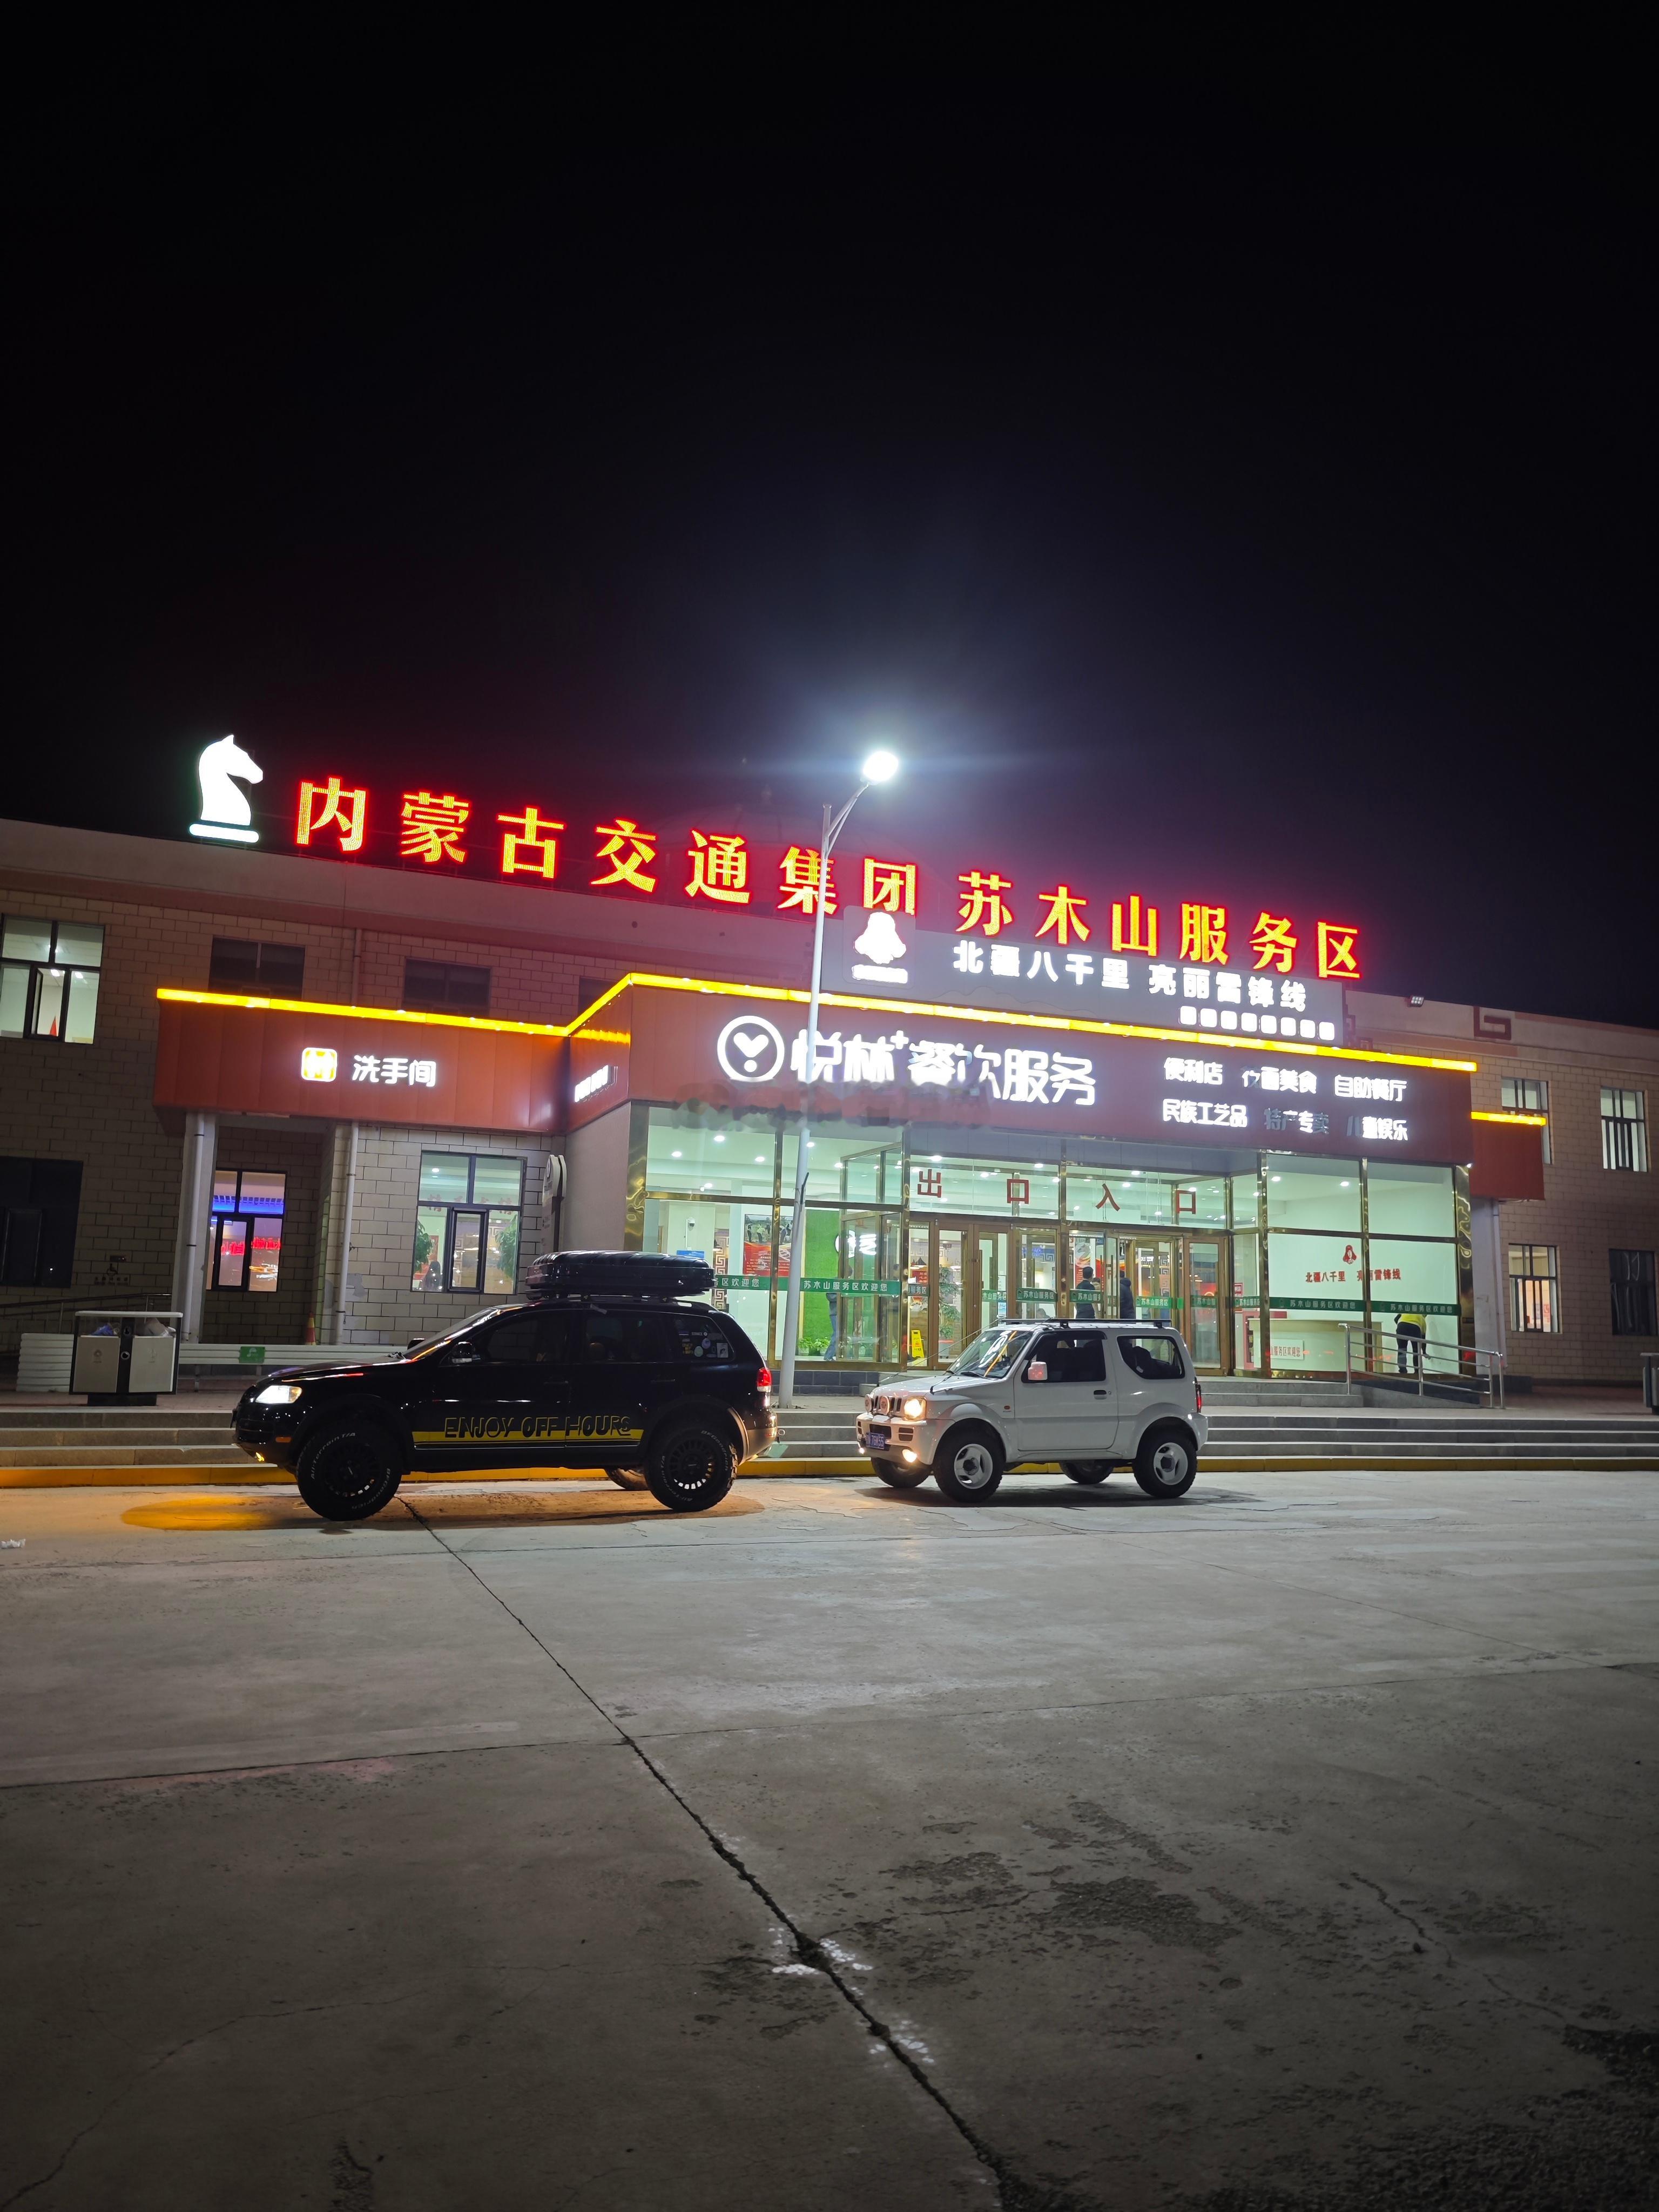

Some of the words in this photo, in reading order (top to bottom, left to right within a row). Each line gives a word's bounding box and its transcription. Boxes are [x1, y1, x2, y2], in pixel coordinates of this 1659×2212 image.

[352, 1054, 436, 1087] 洗手间
[1163, 1057, 1223, 1085] 便利店
[1334, 1074, 1407, 1102] 自助餐厅
[1162, 1098, 1248, 1128] 民族工艺品
[803, 1280, 887, 1292] 苏木山服务区欢迎您
[1305, 1271, 1346, 1283] 北疆八千里
[1290, 1299, 1356, 1309] 苏木山服务区欢迎您
[444, 1417, 514, 1438] ENJOY
[521, 1416, 559, 1438] OFF
[565, 1415, 631, 1437] HOURS
